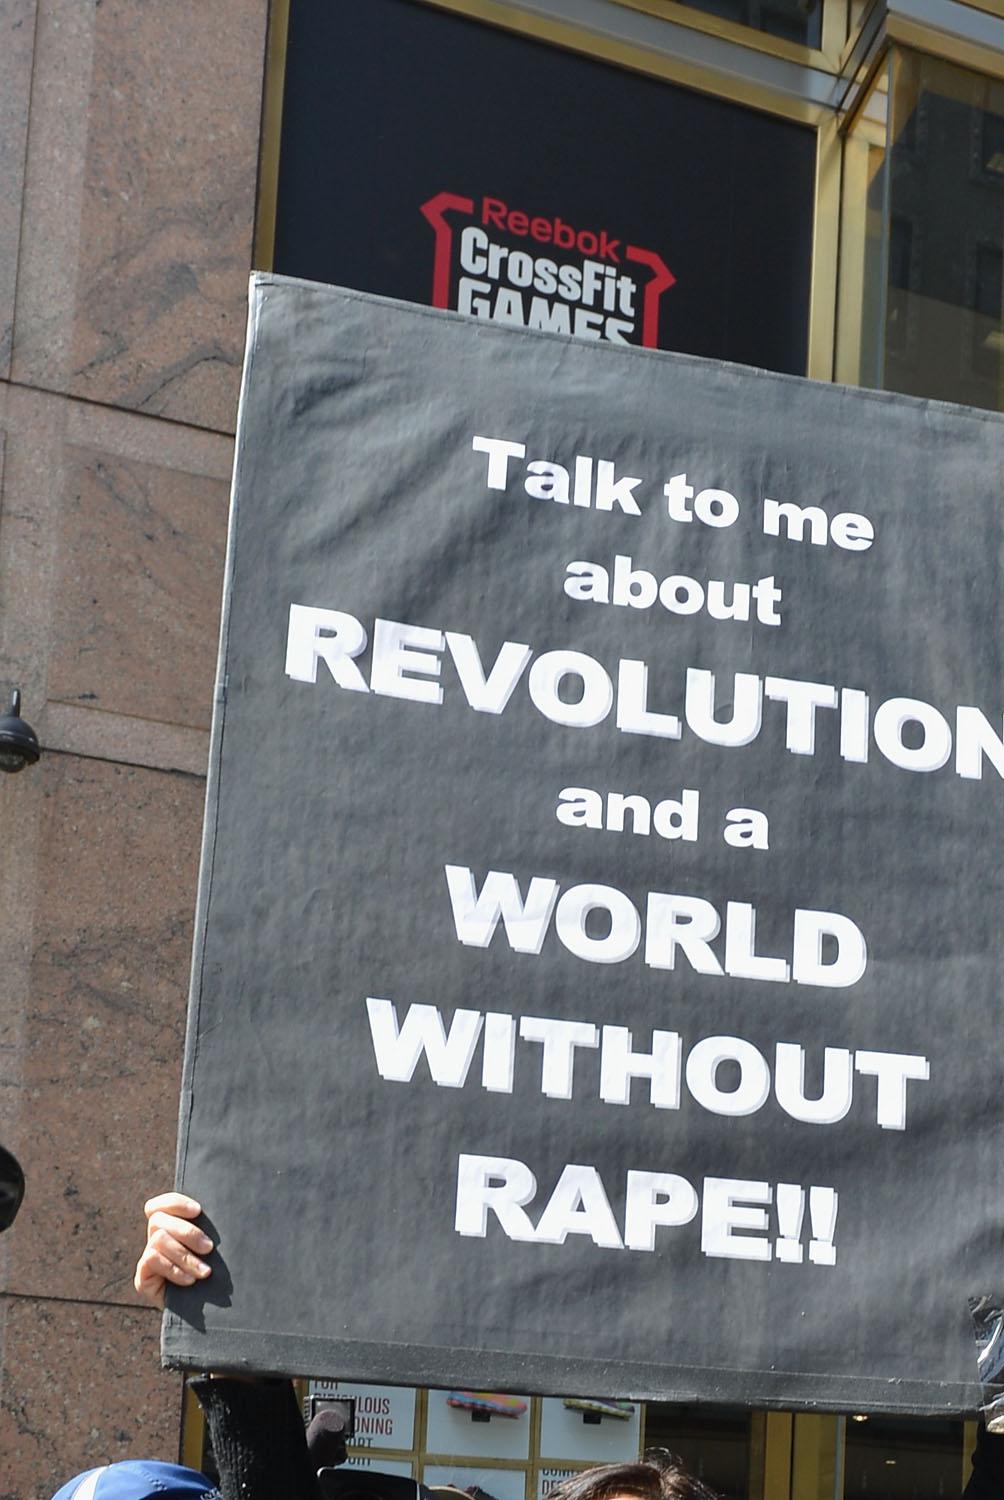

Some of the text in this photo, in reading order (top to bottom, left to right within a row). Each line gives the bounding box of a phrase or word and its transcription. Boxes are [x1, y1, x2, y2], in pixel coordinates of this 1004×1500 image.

[460, 226, 636, 316] CrossFit
[481, 197, 620, 262] Reebok
[473, 436, 873, 550] Talk to me
[564, 555, 781, 625] about
[557, 788, 768, 849] and a
[446, 865, 866, 987] WORLD
[367, 998, 929, 1129] WITHOUT
[455, 1154, 837, 1265] RAPE!!
